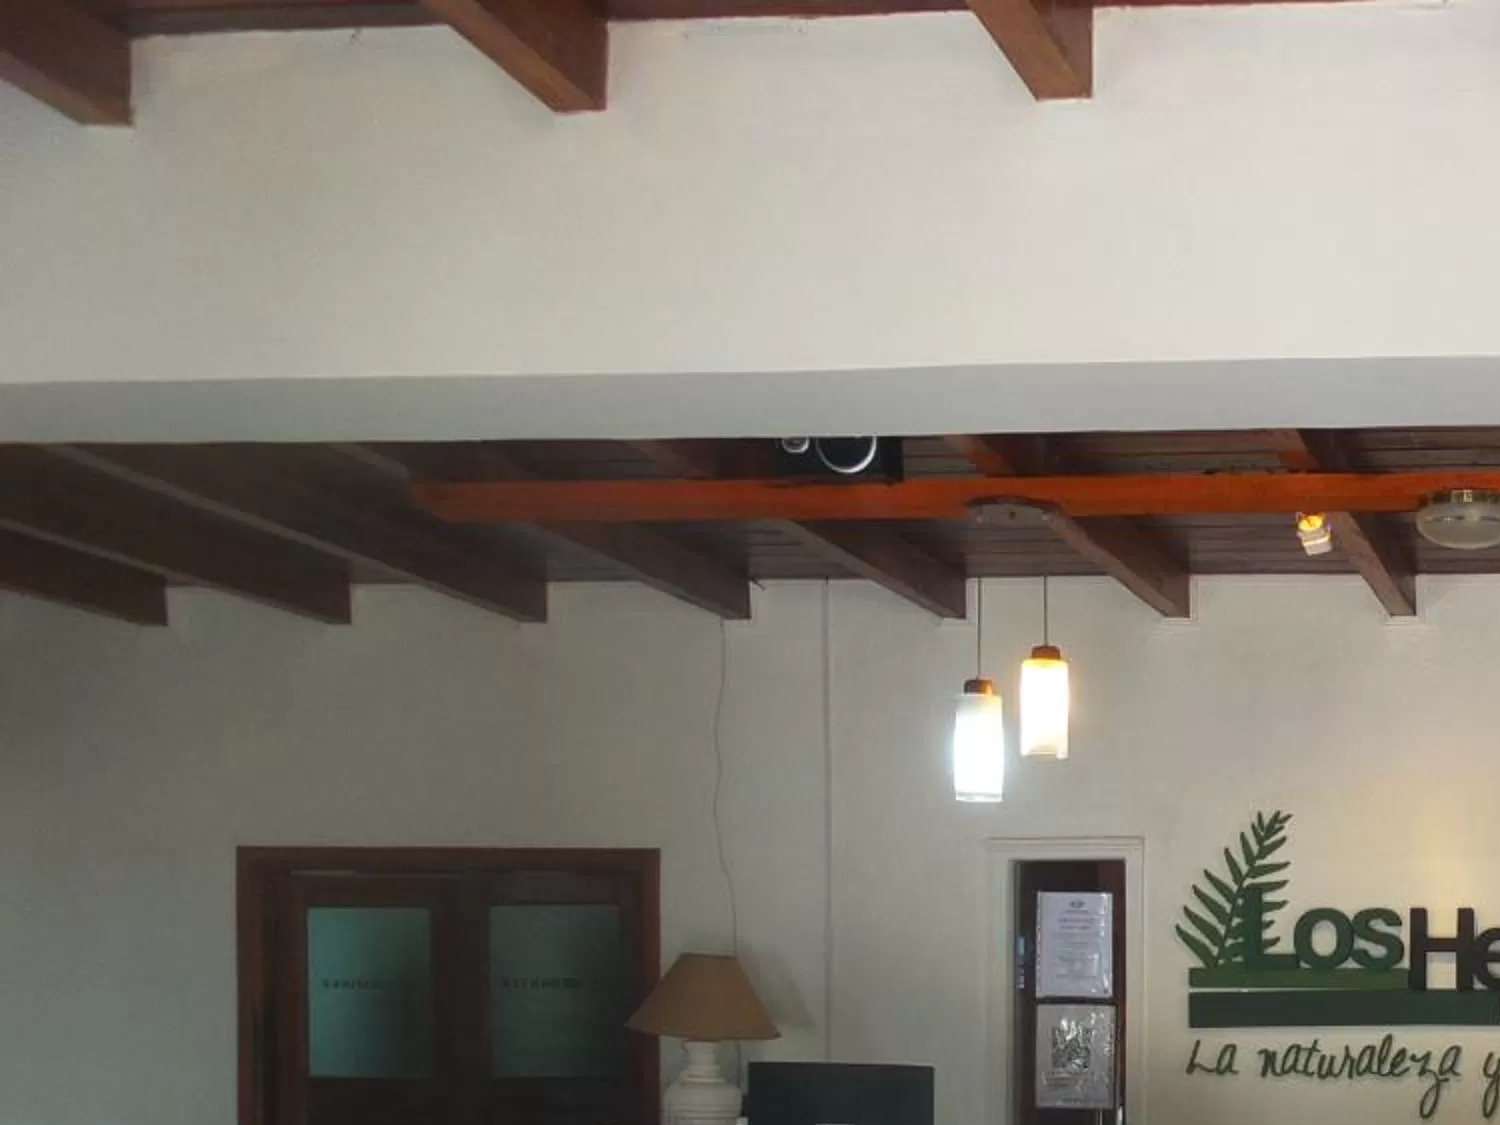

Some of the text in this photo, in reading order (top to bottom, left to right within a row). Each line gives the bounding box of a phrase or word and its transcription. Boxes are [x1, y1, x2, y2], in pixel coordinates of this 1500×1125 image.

[1245, 886, 1404, 971] Los
[1185, 1036, 1238, 1077] La
[1259, 1033, 1462, 1119] naturaleza
